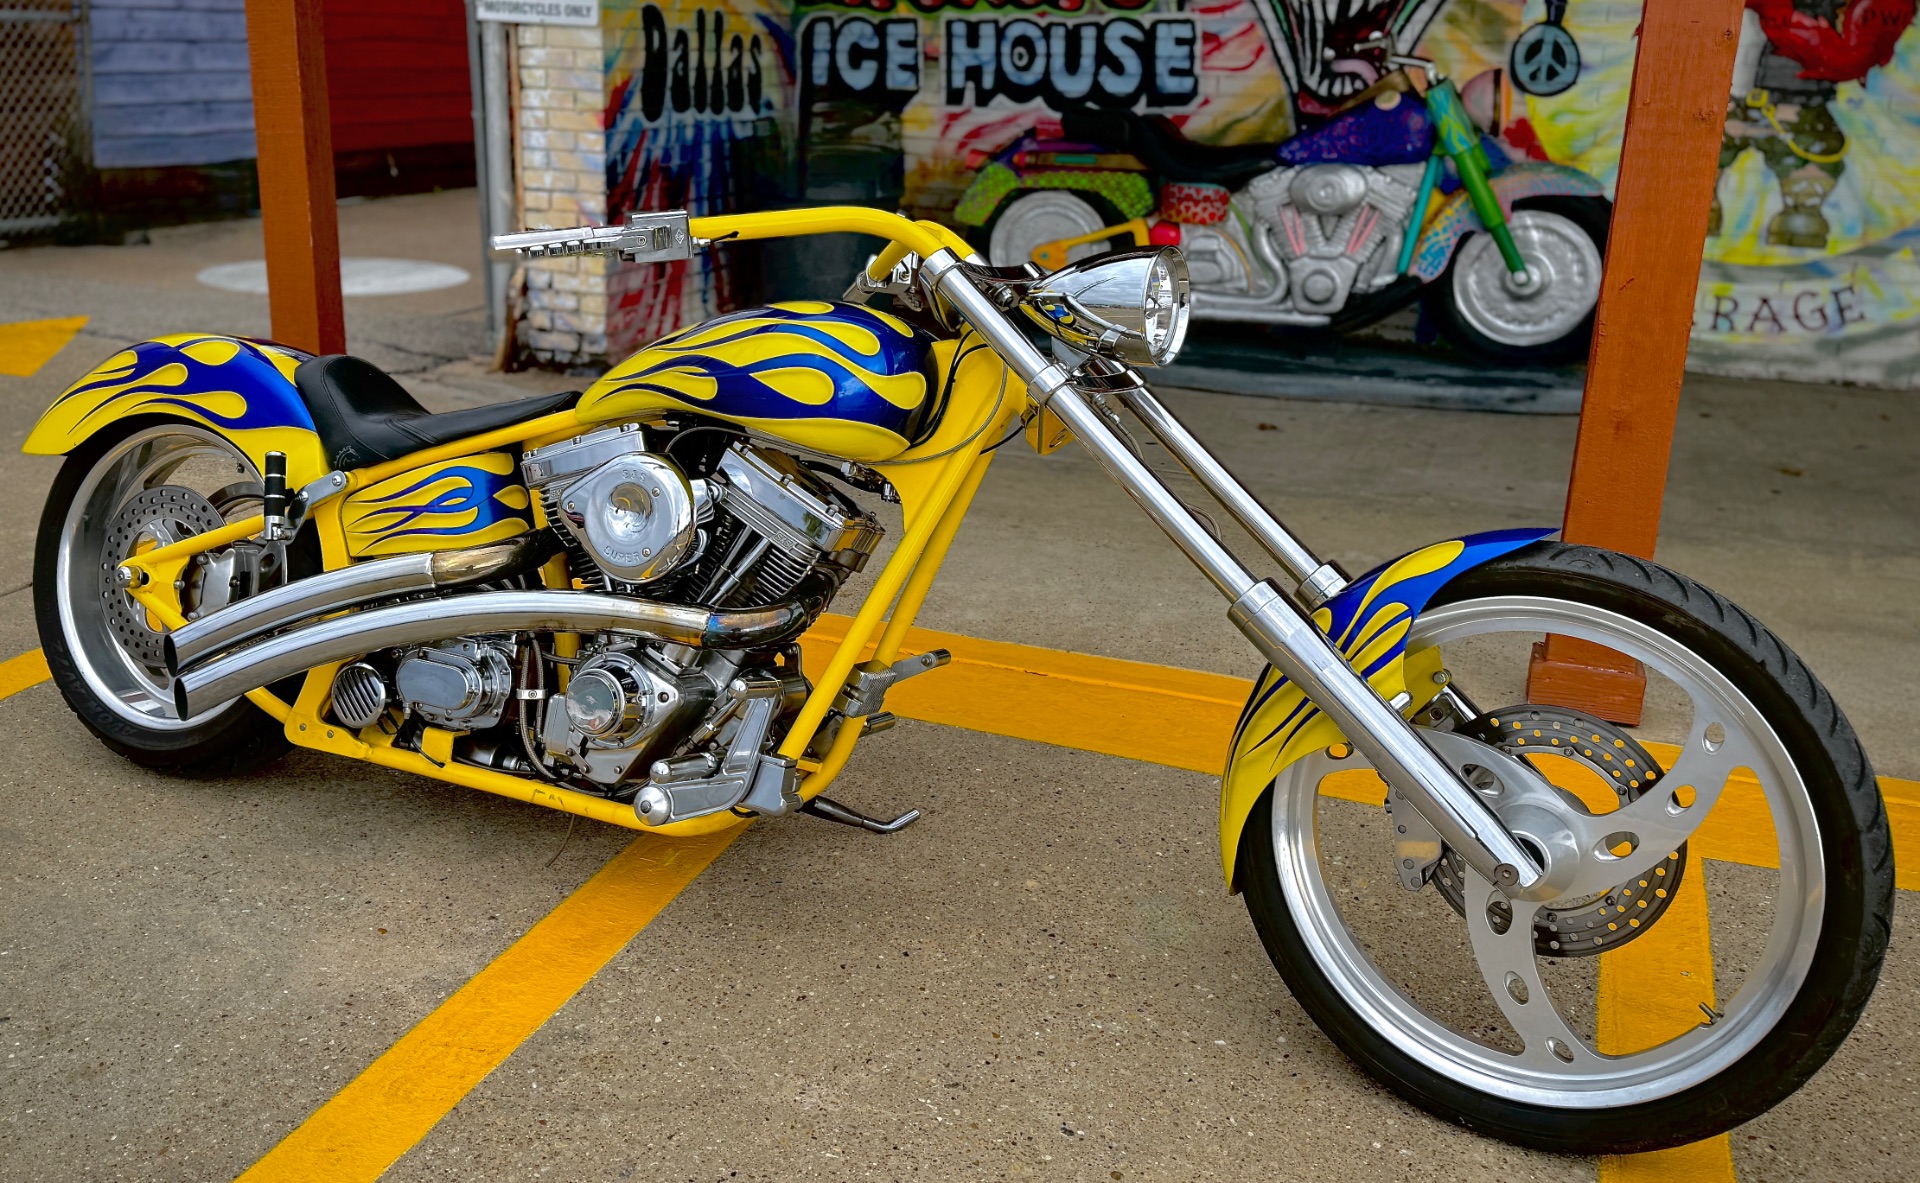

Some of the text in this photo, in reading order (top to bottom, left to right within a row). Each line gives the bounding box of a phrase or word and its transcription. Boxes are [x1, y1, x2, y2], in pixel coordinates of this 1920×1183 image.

[483, 1, 594, 18] MOTORCYCLES ONLY
[641, 4, 763, 123] Dallas
[806, 18, 1198, 98] ICE HOUSE
[1692, 284, 1865, 332] RAGE
[603, 545, 640, 563] SUPER
[83, 698, 138, 738] AVON
